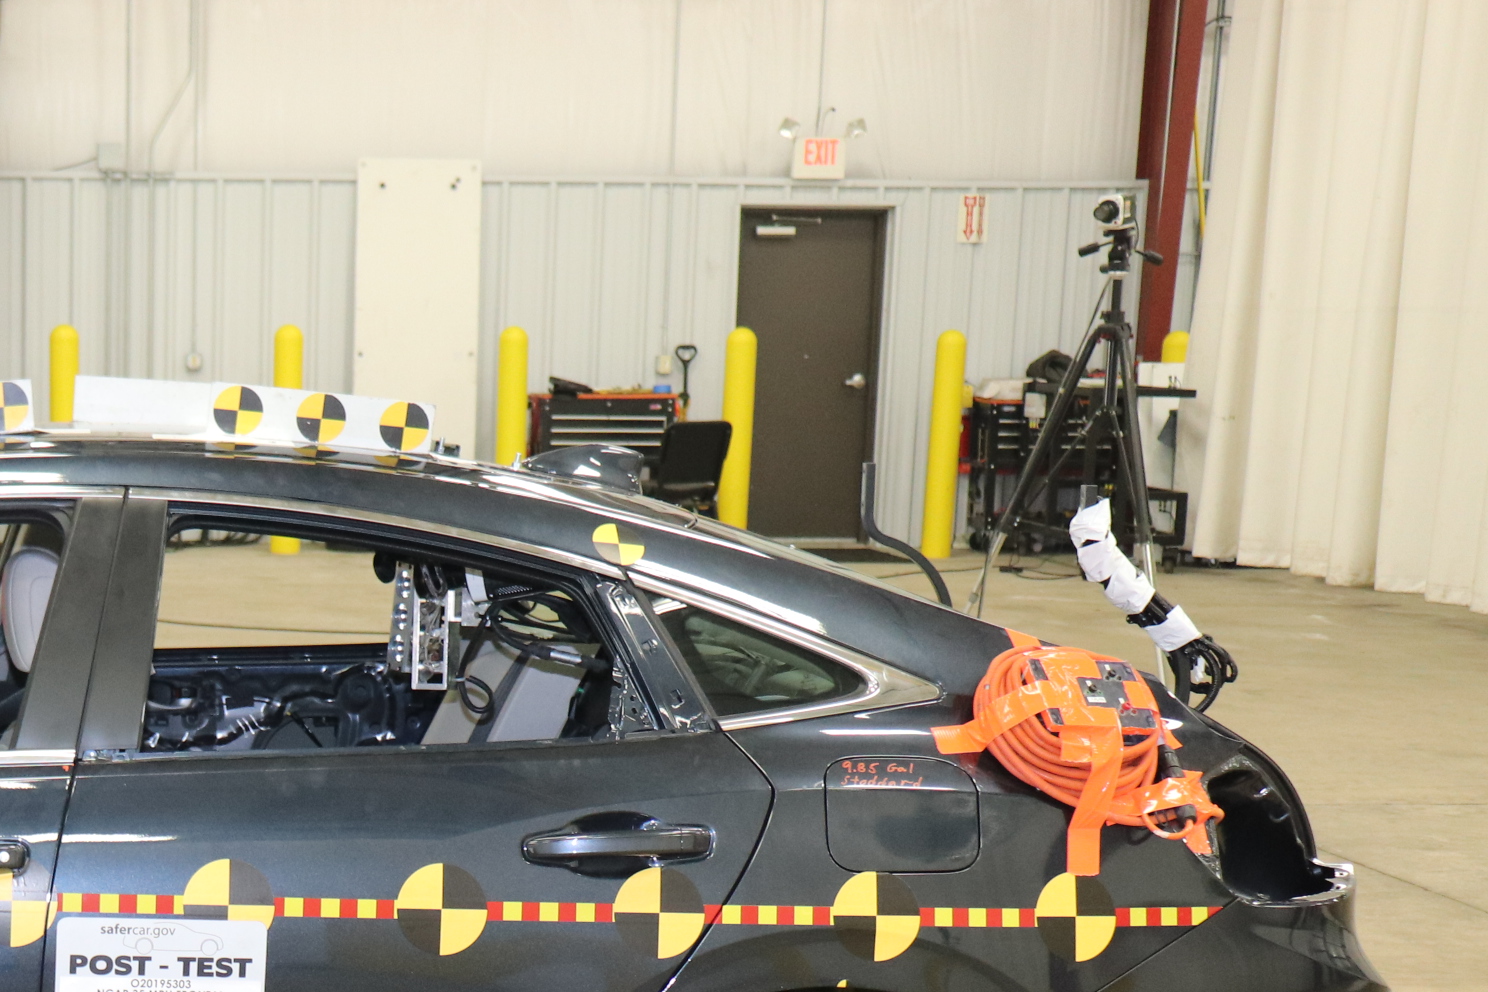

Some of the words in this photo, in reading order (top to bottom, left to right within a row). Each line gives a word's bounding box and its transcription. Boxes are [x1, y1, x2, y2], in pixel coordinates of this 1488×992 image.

[803, 138, 839, 166] EXIT
[841, 761, 880, 774] 9.85
[886, 762, 915, 774] Gal
[100, 923, 176, 939] safercar.gov
[69, 954, 152, 976] POST
[177, 956, 253, 978] TEST
